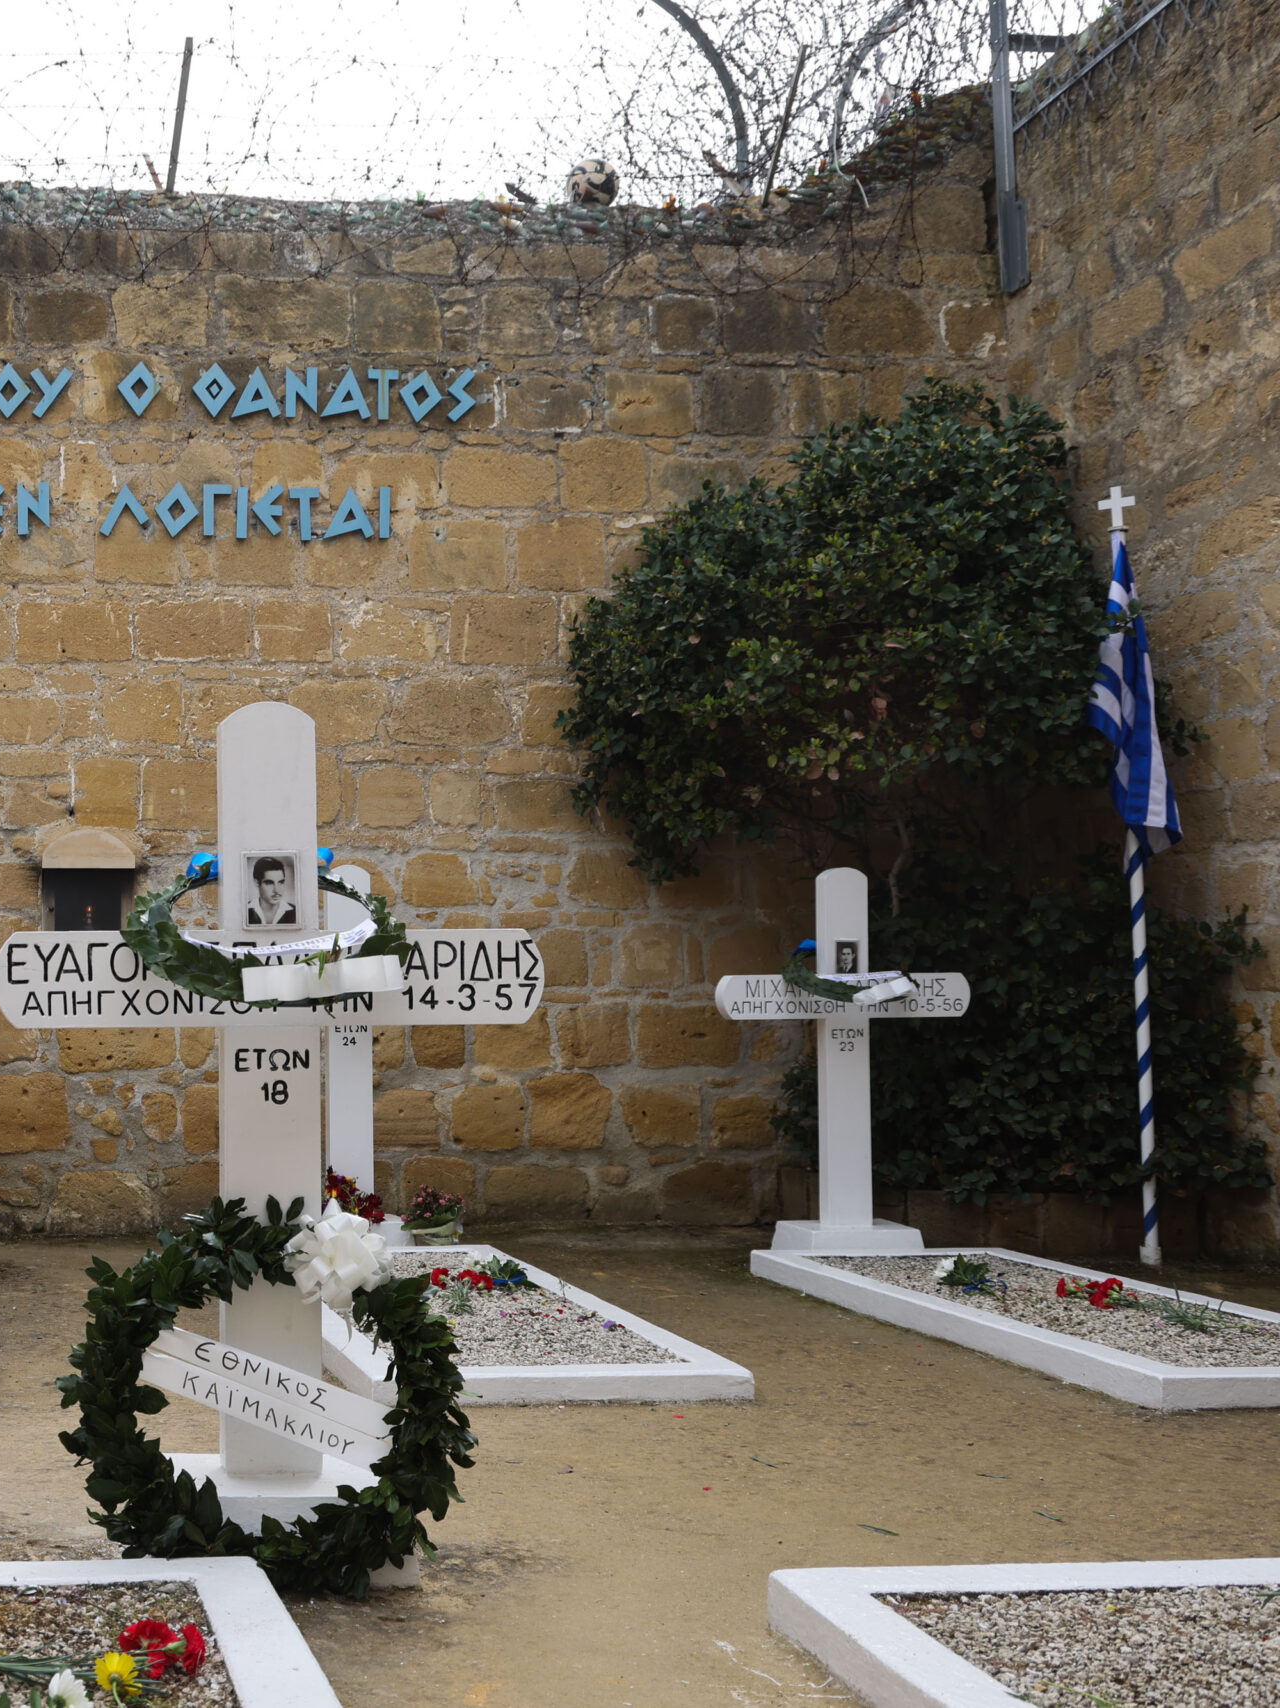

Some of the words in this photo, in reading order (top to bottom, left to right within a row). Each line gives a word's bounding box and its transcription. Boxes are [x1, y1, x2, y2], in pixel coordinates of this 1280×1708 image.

[117, 361, 161, 417] Ο
[192, 362, 477, 423] ΘΑΝΑΤΟΣ
[99, 481, 391, 541] ΛΟΓΙΕΤΑΙ
[7, 942, 219, 984] ΕΥΑΓΟ
[232, 939, 542, 984] ΑΡΙΔΗΣ
[900, 998, 964, 1013] 10-5-56
[342, 1036, 357, 1046] 24
[831, 1028, 865, 1040] ΕΤΩΝ
[839, 1041, 855, 1052] 23
[234, 1048, 310, 1073] ΕΤΩΝ
[260, 1079, 289, 1106] 18
[194, 1341, 328, 1412] ΕΘΝΙΚΟΣ
